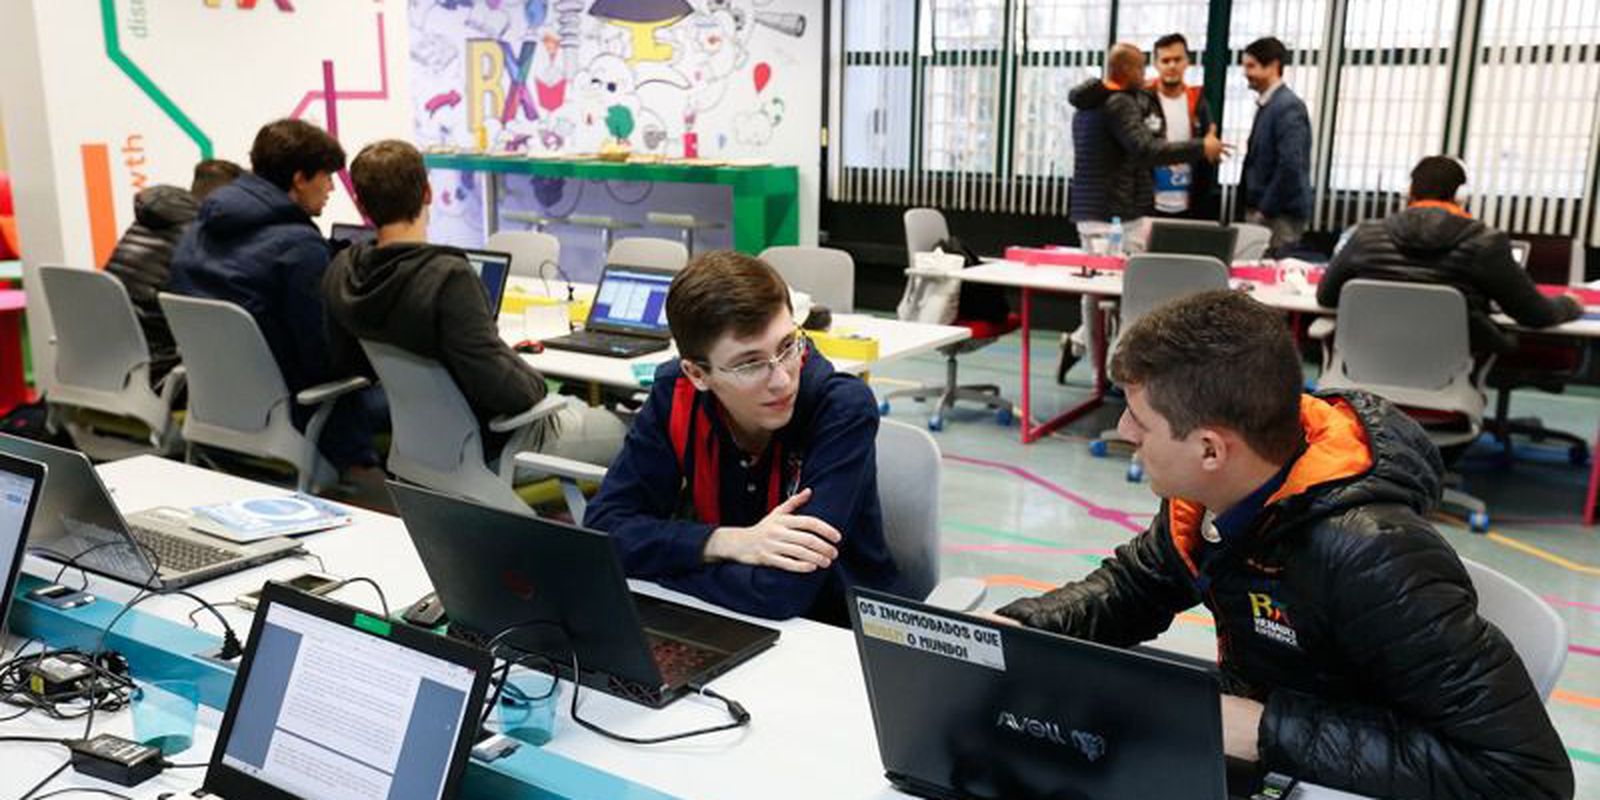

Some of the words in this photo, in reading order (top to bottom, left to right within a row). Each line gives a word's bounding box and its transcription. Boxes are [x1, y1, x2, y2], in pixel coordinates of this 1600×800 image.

[466, 38, 539, 133] RX
[860, 601, 877, 616] OS
[879, 606, 971, 640] INCOMODADOS
[973, 629, 1000, 647] QUE
[907, 633, 916, 645] O
